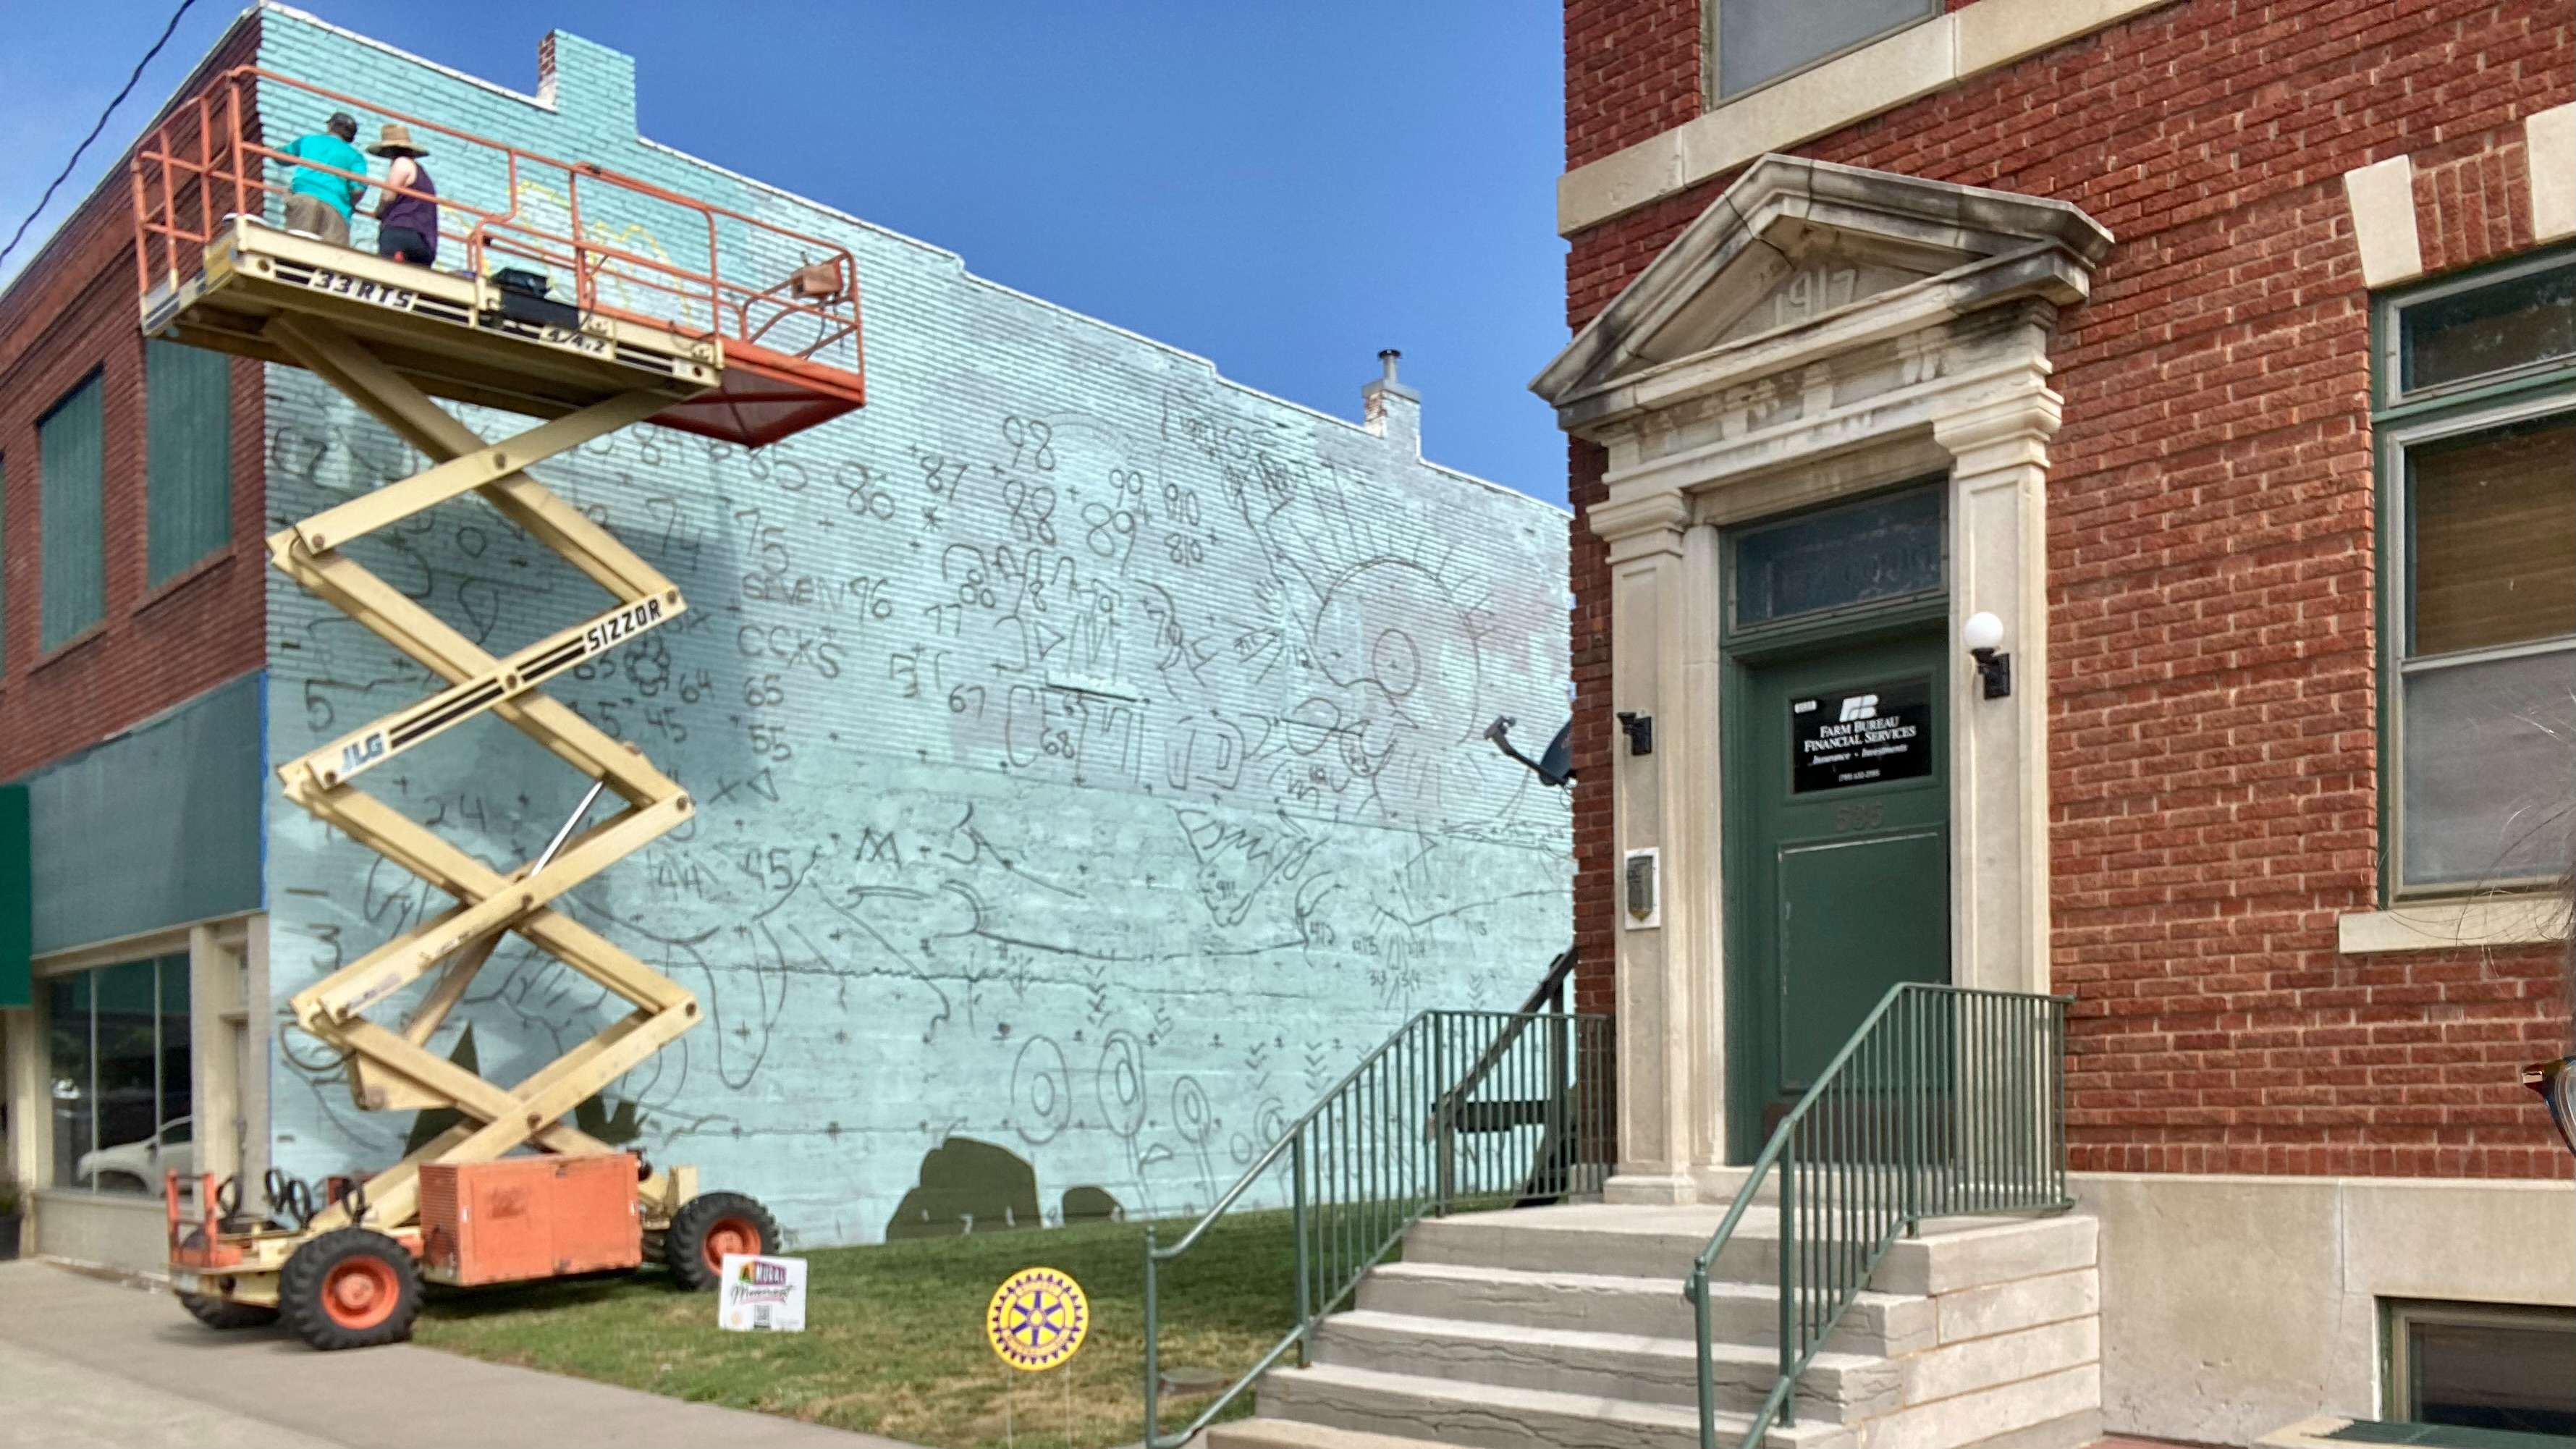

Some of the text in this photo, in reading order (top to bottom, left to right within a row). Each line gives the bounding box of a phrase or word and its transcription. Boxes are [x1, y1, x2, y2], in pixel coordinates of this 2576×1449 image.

[1775, 263, 1858, 325] 1917
[1002, 415, 1055, 470] 98
[340, 598, 662, 772] JLG SIZZOR
[1804, 725, 1917, 752] FINANCIAL SERVICES
[1820, 716, 1901, 738] FARM BUREAU
